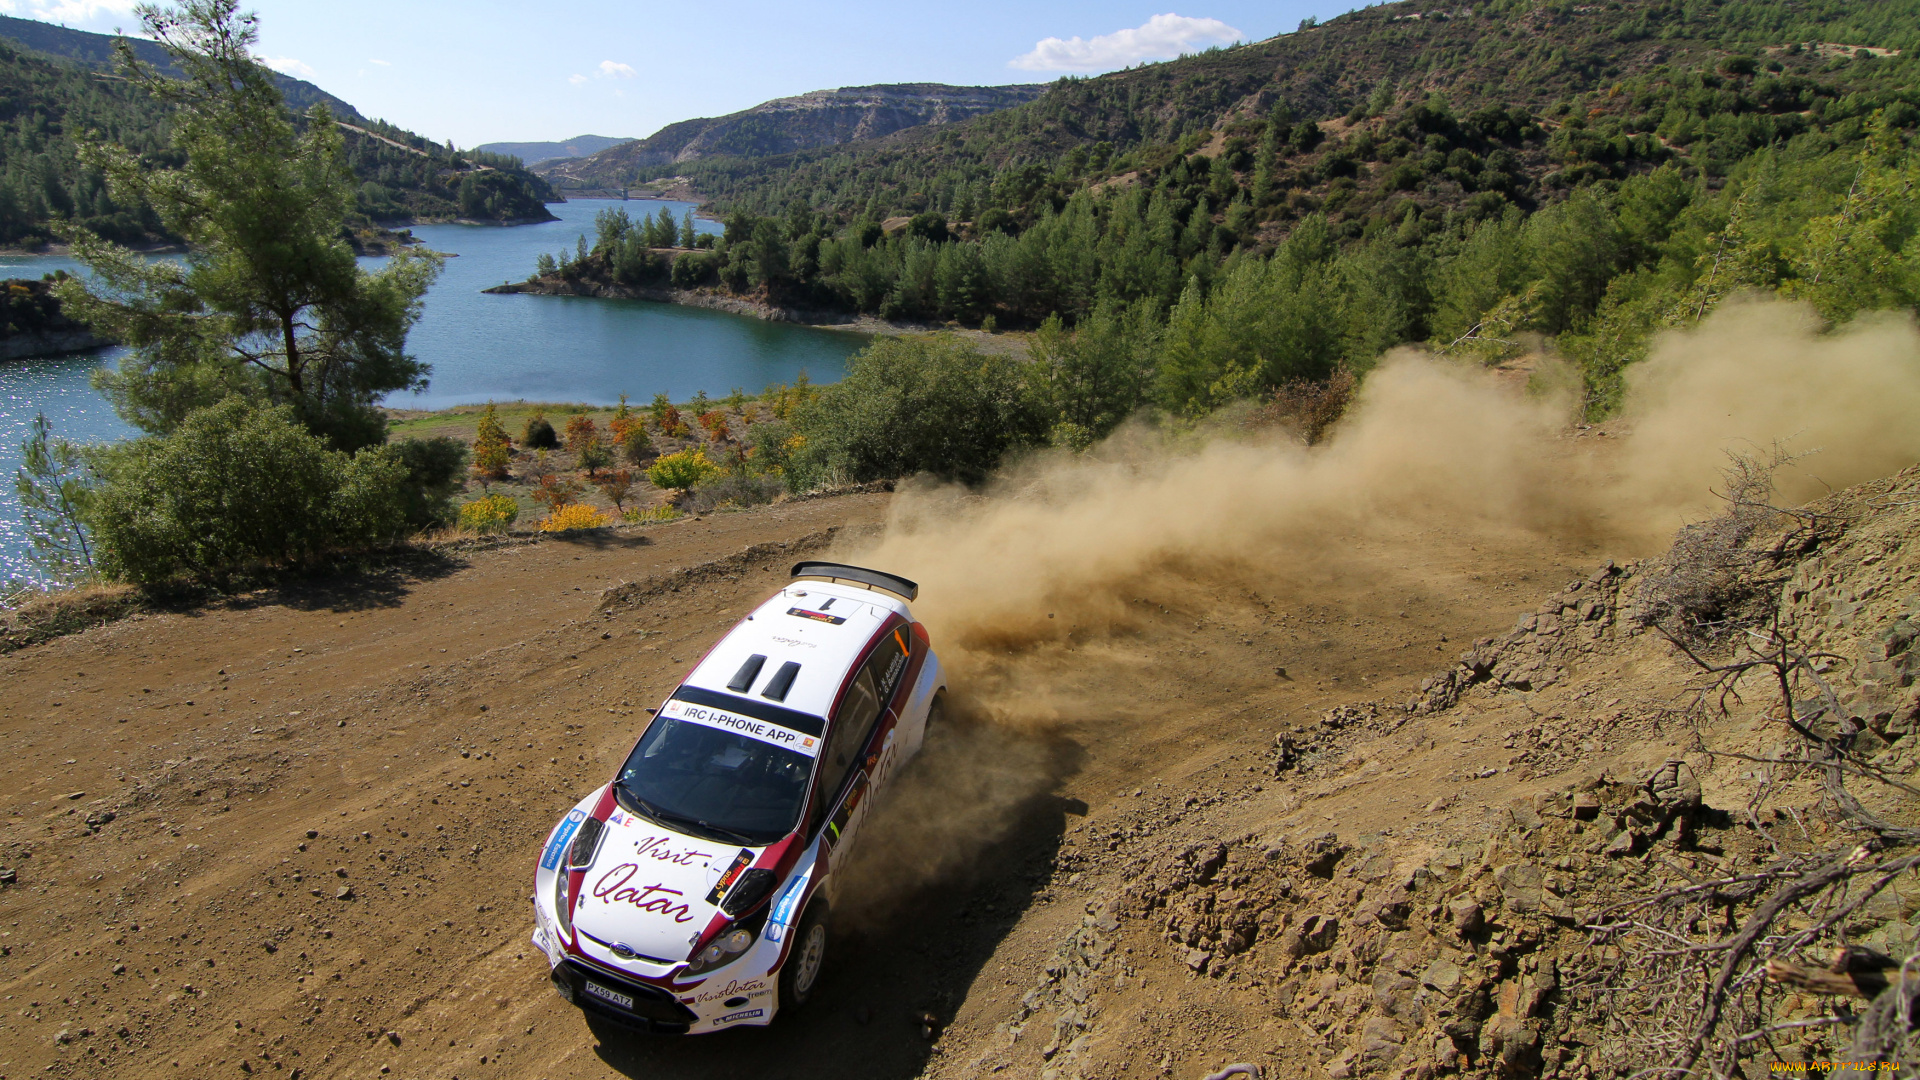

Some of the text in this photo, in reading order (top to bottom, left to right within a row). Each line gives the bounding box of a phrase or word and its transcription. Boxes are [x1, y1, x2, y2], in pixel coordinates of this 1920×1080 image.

[684, 707, 795, 743] IRC I-PHONE APP
[558, 822, 575, 843] Leptos
[637, 836, 712, 865] Visit
[715, 869, 732, 890] Cyprus
[593, 863, 694, 923] Qatar
[775, 897, 789, 921] Leptos
[587, 982, 632, 1007] PX59 ATZ
[725, 979, 766, 995] Qatar
[725, 1010, 761, 1021] MICHELIN
